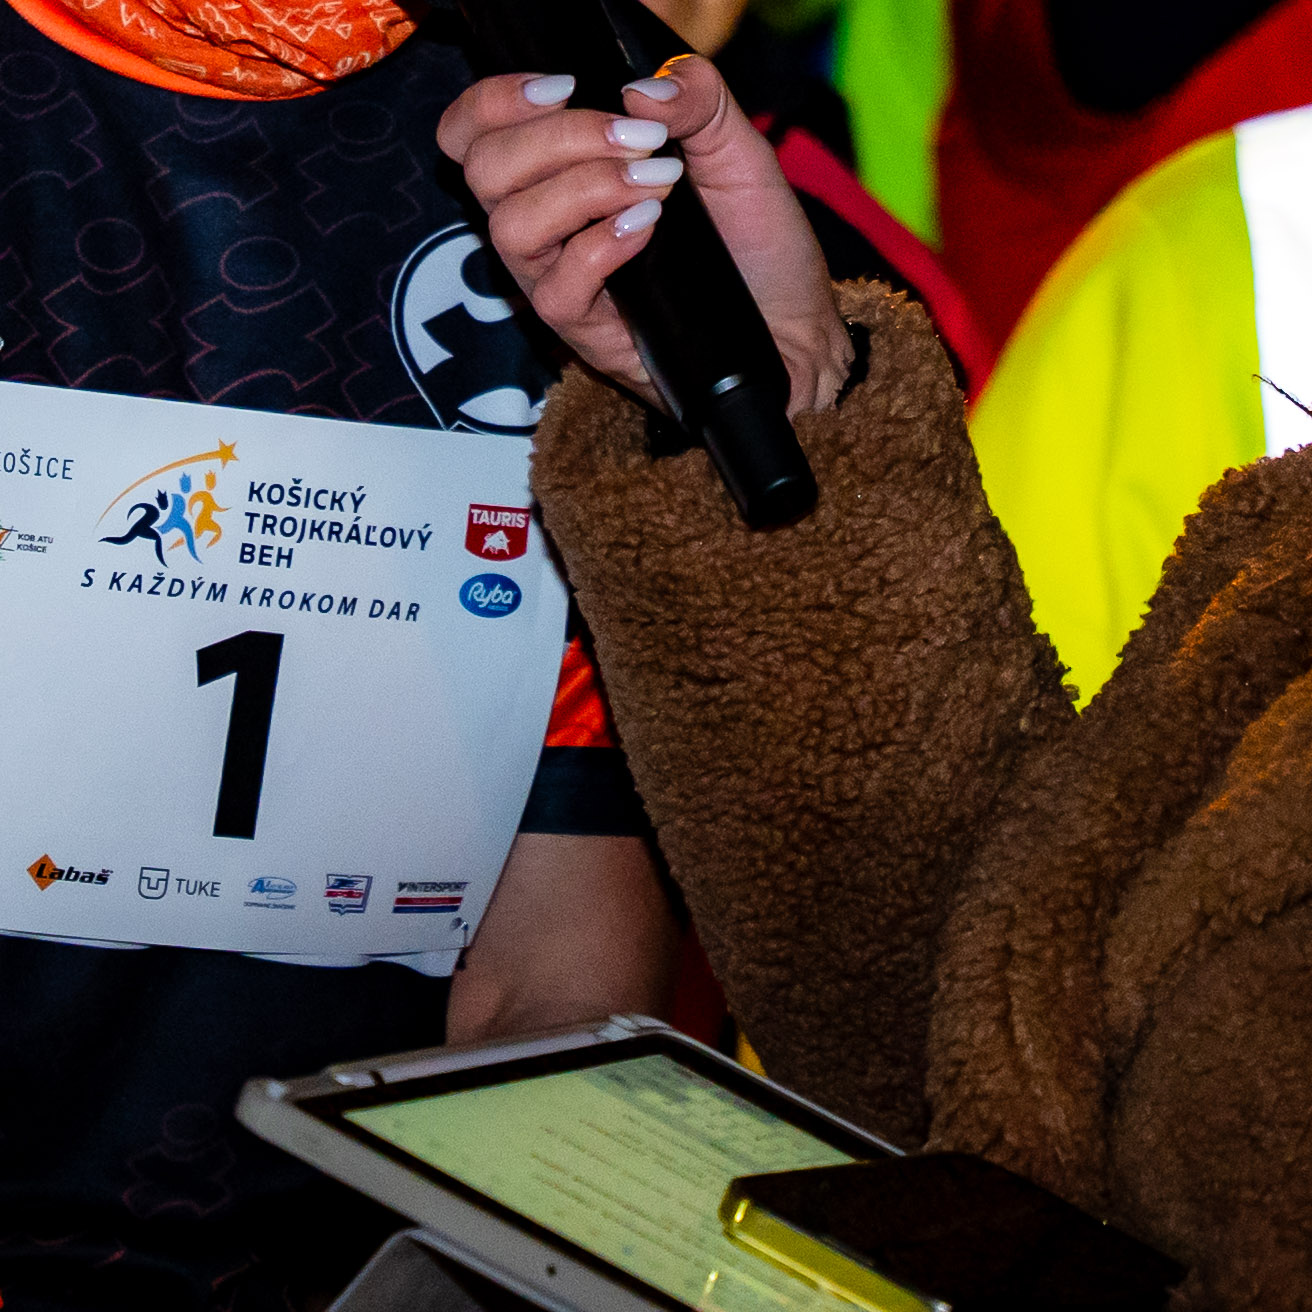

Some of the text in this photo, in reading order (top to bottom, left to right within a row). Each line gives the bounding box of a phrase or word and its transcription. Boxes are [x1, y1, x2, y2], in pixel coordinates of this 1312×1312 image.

[247, 477, 367, 514] KOŠICKÝ
[243, 511, 434, 552] TROJKRÁĽOVÝ
[470, 508, 526, 530] TAURIS
[238, 542, 294, 569] BEH
[80, 568, 421, 622] S KAŽDÝM KROKOM DAR
[467, 581, 515, 608] Ryba
[196, 630, 285, 840] 1
[34, 861, 112, 886] Labaš
[175, 878, 222, 898] TUKE
